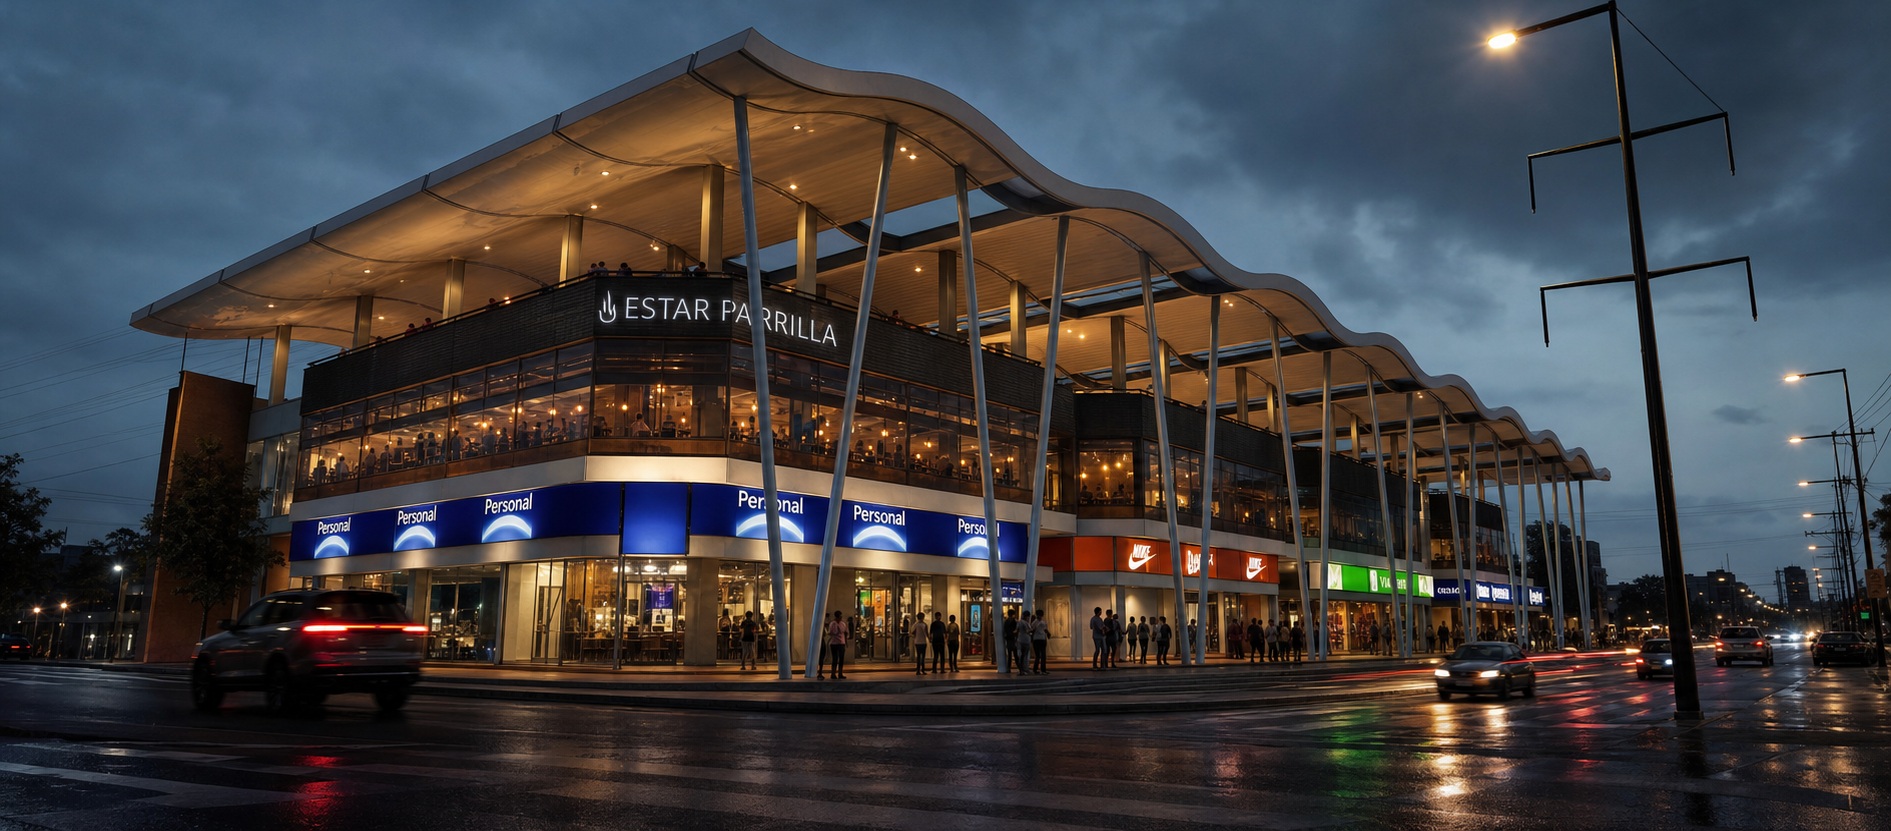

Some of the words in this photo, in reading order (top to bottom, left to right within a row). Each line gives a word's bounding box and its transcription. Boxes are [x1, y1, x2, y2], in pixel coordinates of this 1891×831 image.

[625, 296, 710, 321] ESTAR
[722, 299, 837, 347] PARRILLA
[484, 492, 533, 515] Personal
[738, 489, 804, 515] Pernal
[397, 504, 437, 526] Personal
[853, 504, 906, 527] Personal
[317, 517, 351, 536] Personal
[958, 517, 1000, 538] Persol
[1132, 543, 1151, 559] NIKE
